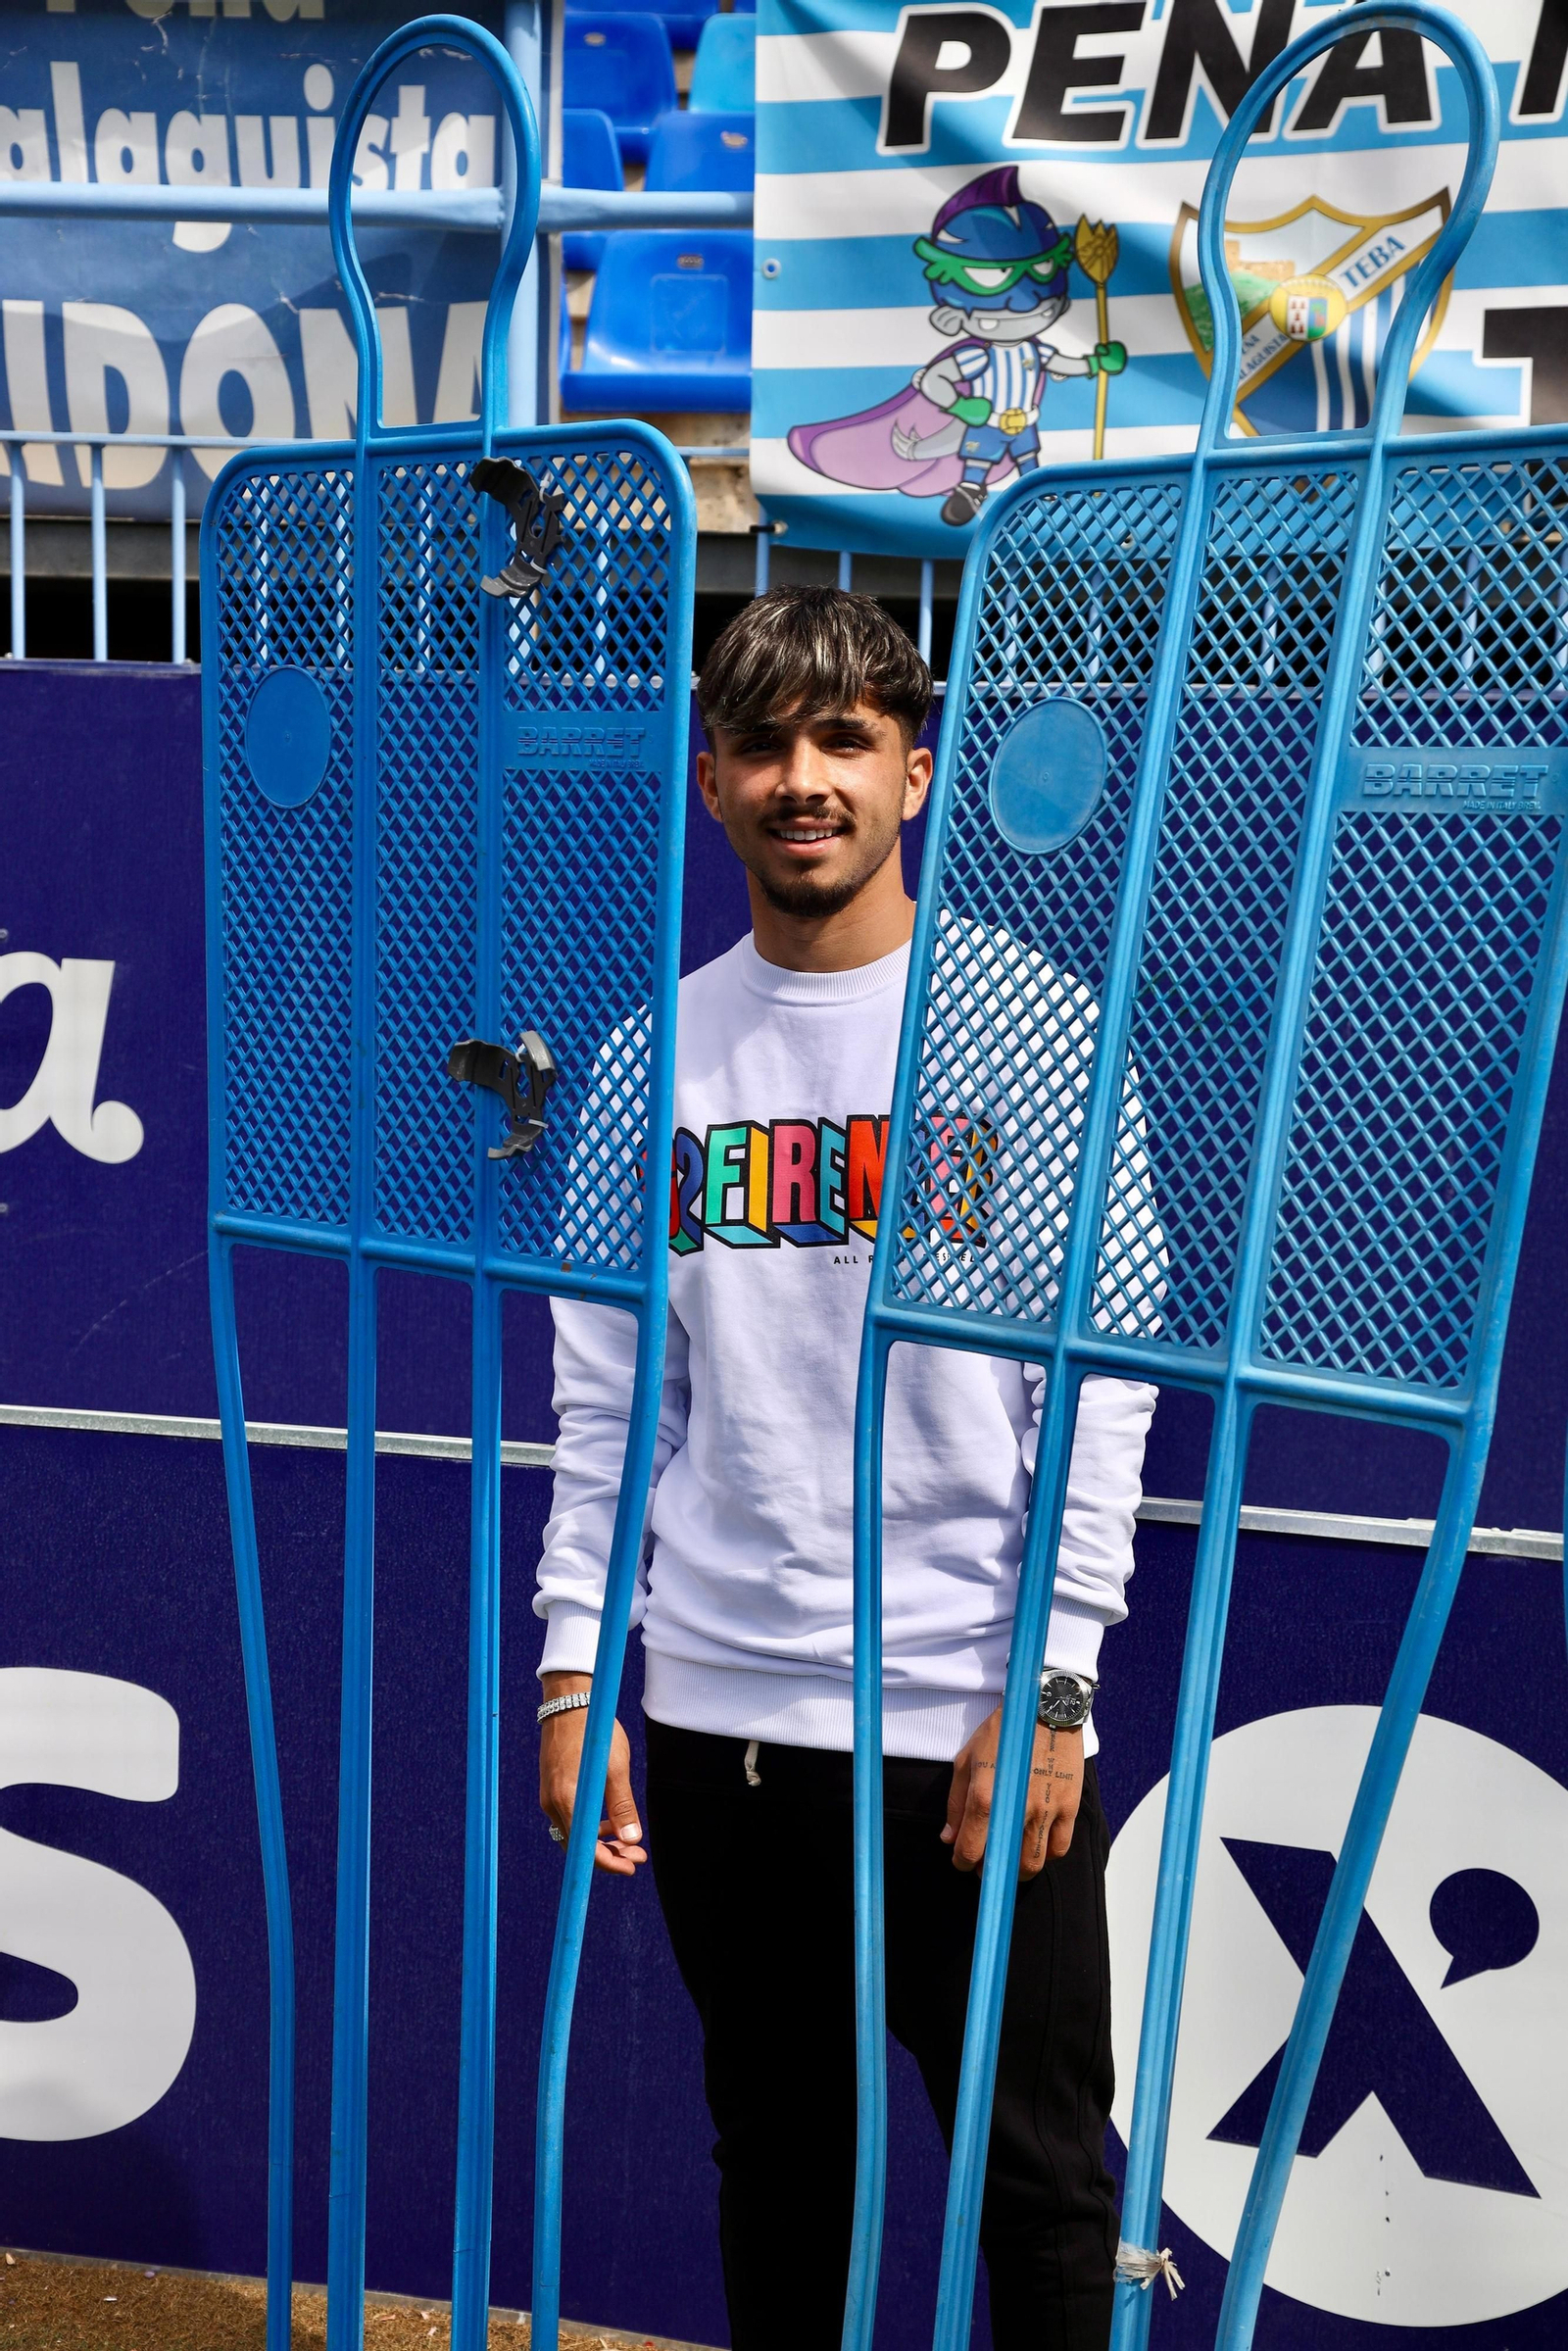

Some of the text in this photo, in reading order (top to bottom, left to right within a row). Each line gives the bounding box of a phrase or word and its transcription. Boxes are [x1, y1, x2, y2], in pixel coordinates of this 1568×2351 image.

[1340, 235, 1406, 289] TEBA
[517, 726, 646, 758] BARRET
[1363, 763, 1548, 799] BARRET
[1463, 800, 1486, 809] MADE
[833, 1255, 858, 1264] ALL
